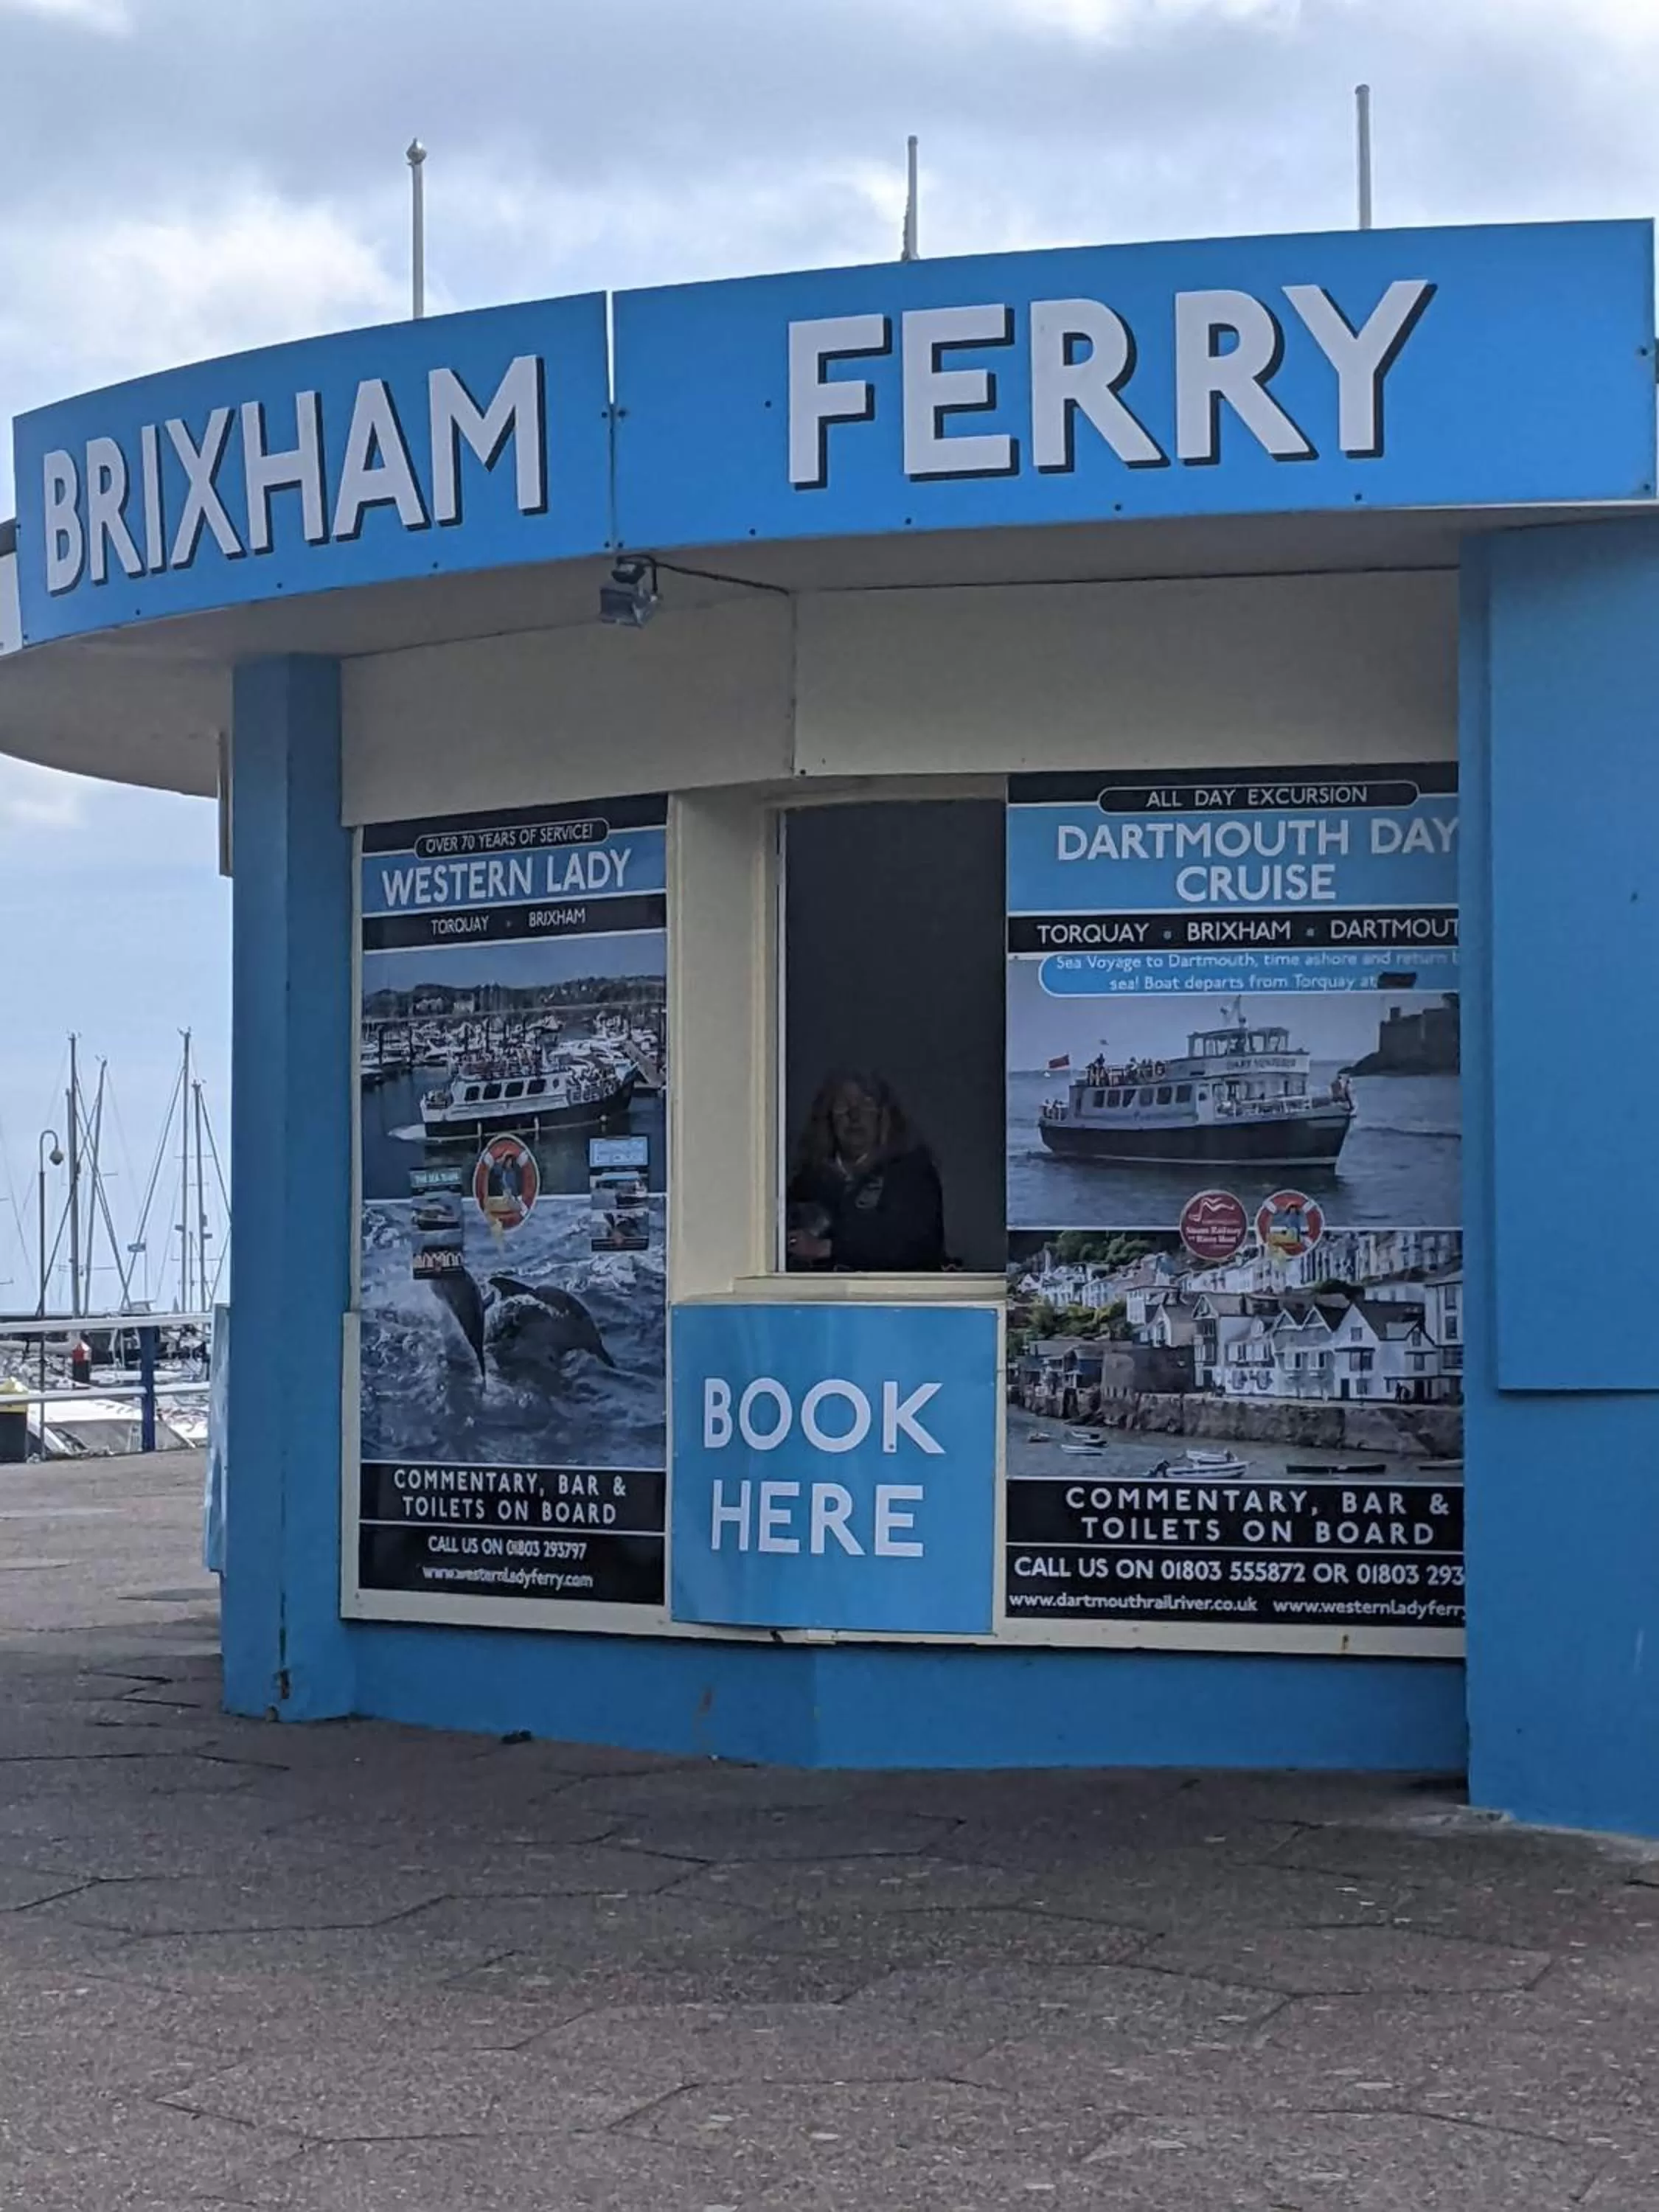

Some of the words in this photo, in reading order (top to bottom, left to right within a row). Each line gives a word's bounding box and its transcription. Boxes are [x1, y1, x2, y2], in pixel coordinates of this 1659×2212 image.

[788, 279, 1437, 490] FERRY
[44, 355, 546, 596] BRIXHAM
[1145, 789, 1182, 807] ALL
[1194, 788, 1236, 806] DAY
[1248, 786, 1368, 805] EXCURSION
[425, 835, 458, 853] OVER
[461, 834, 476, 851] 70
[479, 829, 516, 848] YEARS
[518, 827, 538, 845] OF
[1057, 818, 1350, 861] DARTMOUTH
[1371, 816, 1459, 855] DAY
[381, 858, 533, 907] WESTERN
[546, 848, 632, 894] LADY
[1175, 863, 1337, 902] CRUISE
[431, 914, 490, 936] TORQUAY
[529, 908, 586, 928] BRIXHAM
[1037, 922, 1150, 945] TORQUAY
[1186, 920, 1292, 943] BRIXHAM
[1057, 956, 1082, 970] Sea
[1087, 955, 1141, 973] Voyage
[1147, 955, 1163, 968] to
[1169, 953, 1259, 968] Dartmouth,
[1264, 953, 1300, 966] time
[1304, 951, 1357, 966] ashore
[1361, 950, 1391, 964] and
[1397, 951, 1447, 965] return
[1144, 975, 1180, 990] Boat
[1184, 975, 1245, 992] departs
[1250, 973, 1287, 988] from
[1294, 973, 1355, 990] Torquay
[703, 1377, 946, 1454] BOOK
[394, 1469, 545, 1498] COMMENTARY,
[558, 1474, 599, 1497] BAR
[613, 1475, 627, 1497] &
[402, 1495, 484, 1520] TOILETS
[497, 1499, 529, 1522] ON
[541, 1500, 616, 1525] BOARD
[1065, 1486, 1318, 1517] COMMENTARY,
[1342, 1492, 1407, 1514] BAR
[1429, 1493, 1450, 1515] &
[711, 1479, 925, 1557] HERE
[1081, 1516, 1221, 1542] TOILETS
[1242, 1519, 1293, 1543] ON
[1315, 1520, 1434, 1545] BOARD
[428, 1536, 459, 1553] CALL
[462, 1537, 479, 1554] US
[481, 1538, 504, 1555] ON
[506, 1539, 540, 1557] 01803
[1014, 1557, 1071, 1577] CALL
[1078, 1558, 1109, 1577] US
[1116, 1559, 1154, 1579] ON
[1161, 1559, 1222, 1581] 01803
[1228, 1561, 1306, 1582] 555872
[1312, 1563, 1349, 1583] OR
[1357, 1563, 1419, 1585] 01803
[1426, 1565, 1464, 1585] 293
[1273, 1599, 1466, 1620] www.westernladyferr
